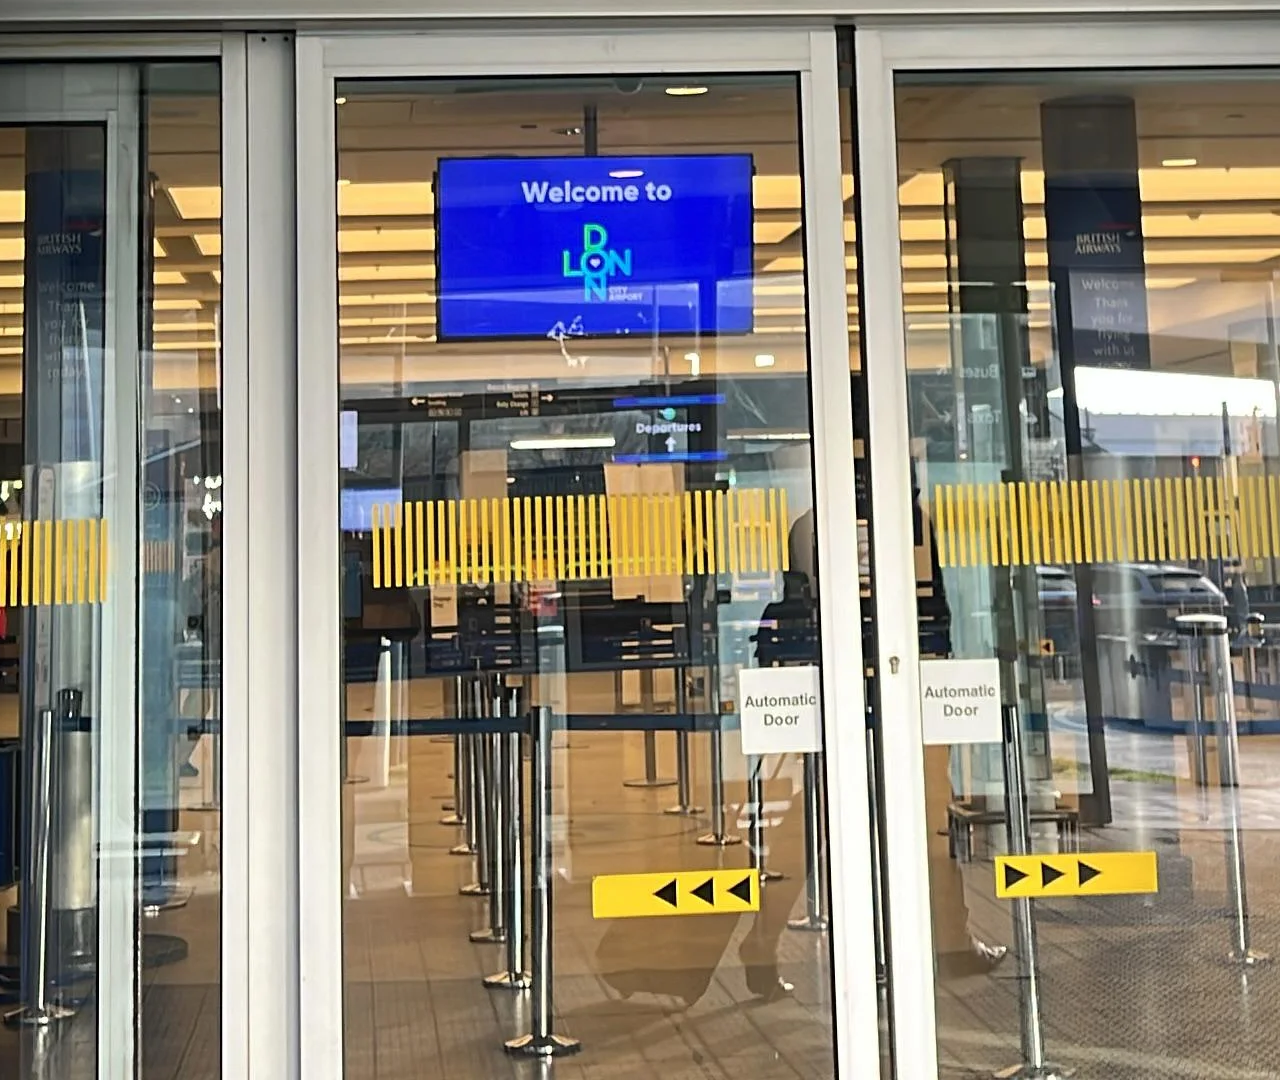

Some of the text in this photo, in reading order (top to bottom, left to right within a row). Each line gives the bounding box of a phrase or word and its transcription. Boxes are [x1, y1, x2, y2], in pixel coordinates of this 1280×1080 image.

[521, 181, 672, 203] Welcome to
[1076, 233, 1120, 245] BRITISH
[1075, 243, 1121, 254] AIRWAYS
[636, 423, 702, 435] Departures
[925, 685, 996, 700] Automatic
[745, 693, 817, 708] Automatic
[943, 705, 979, 717] Door
[764, 714, 800, 726] Door
